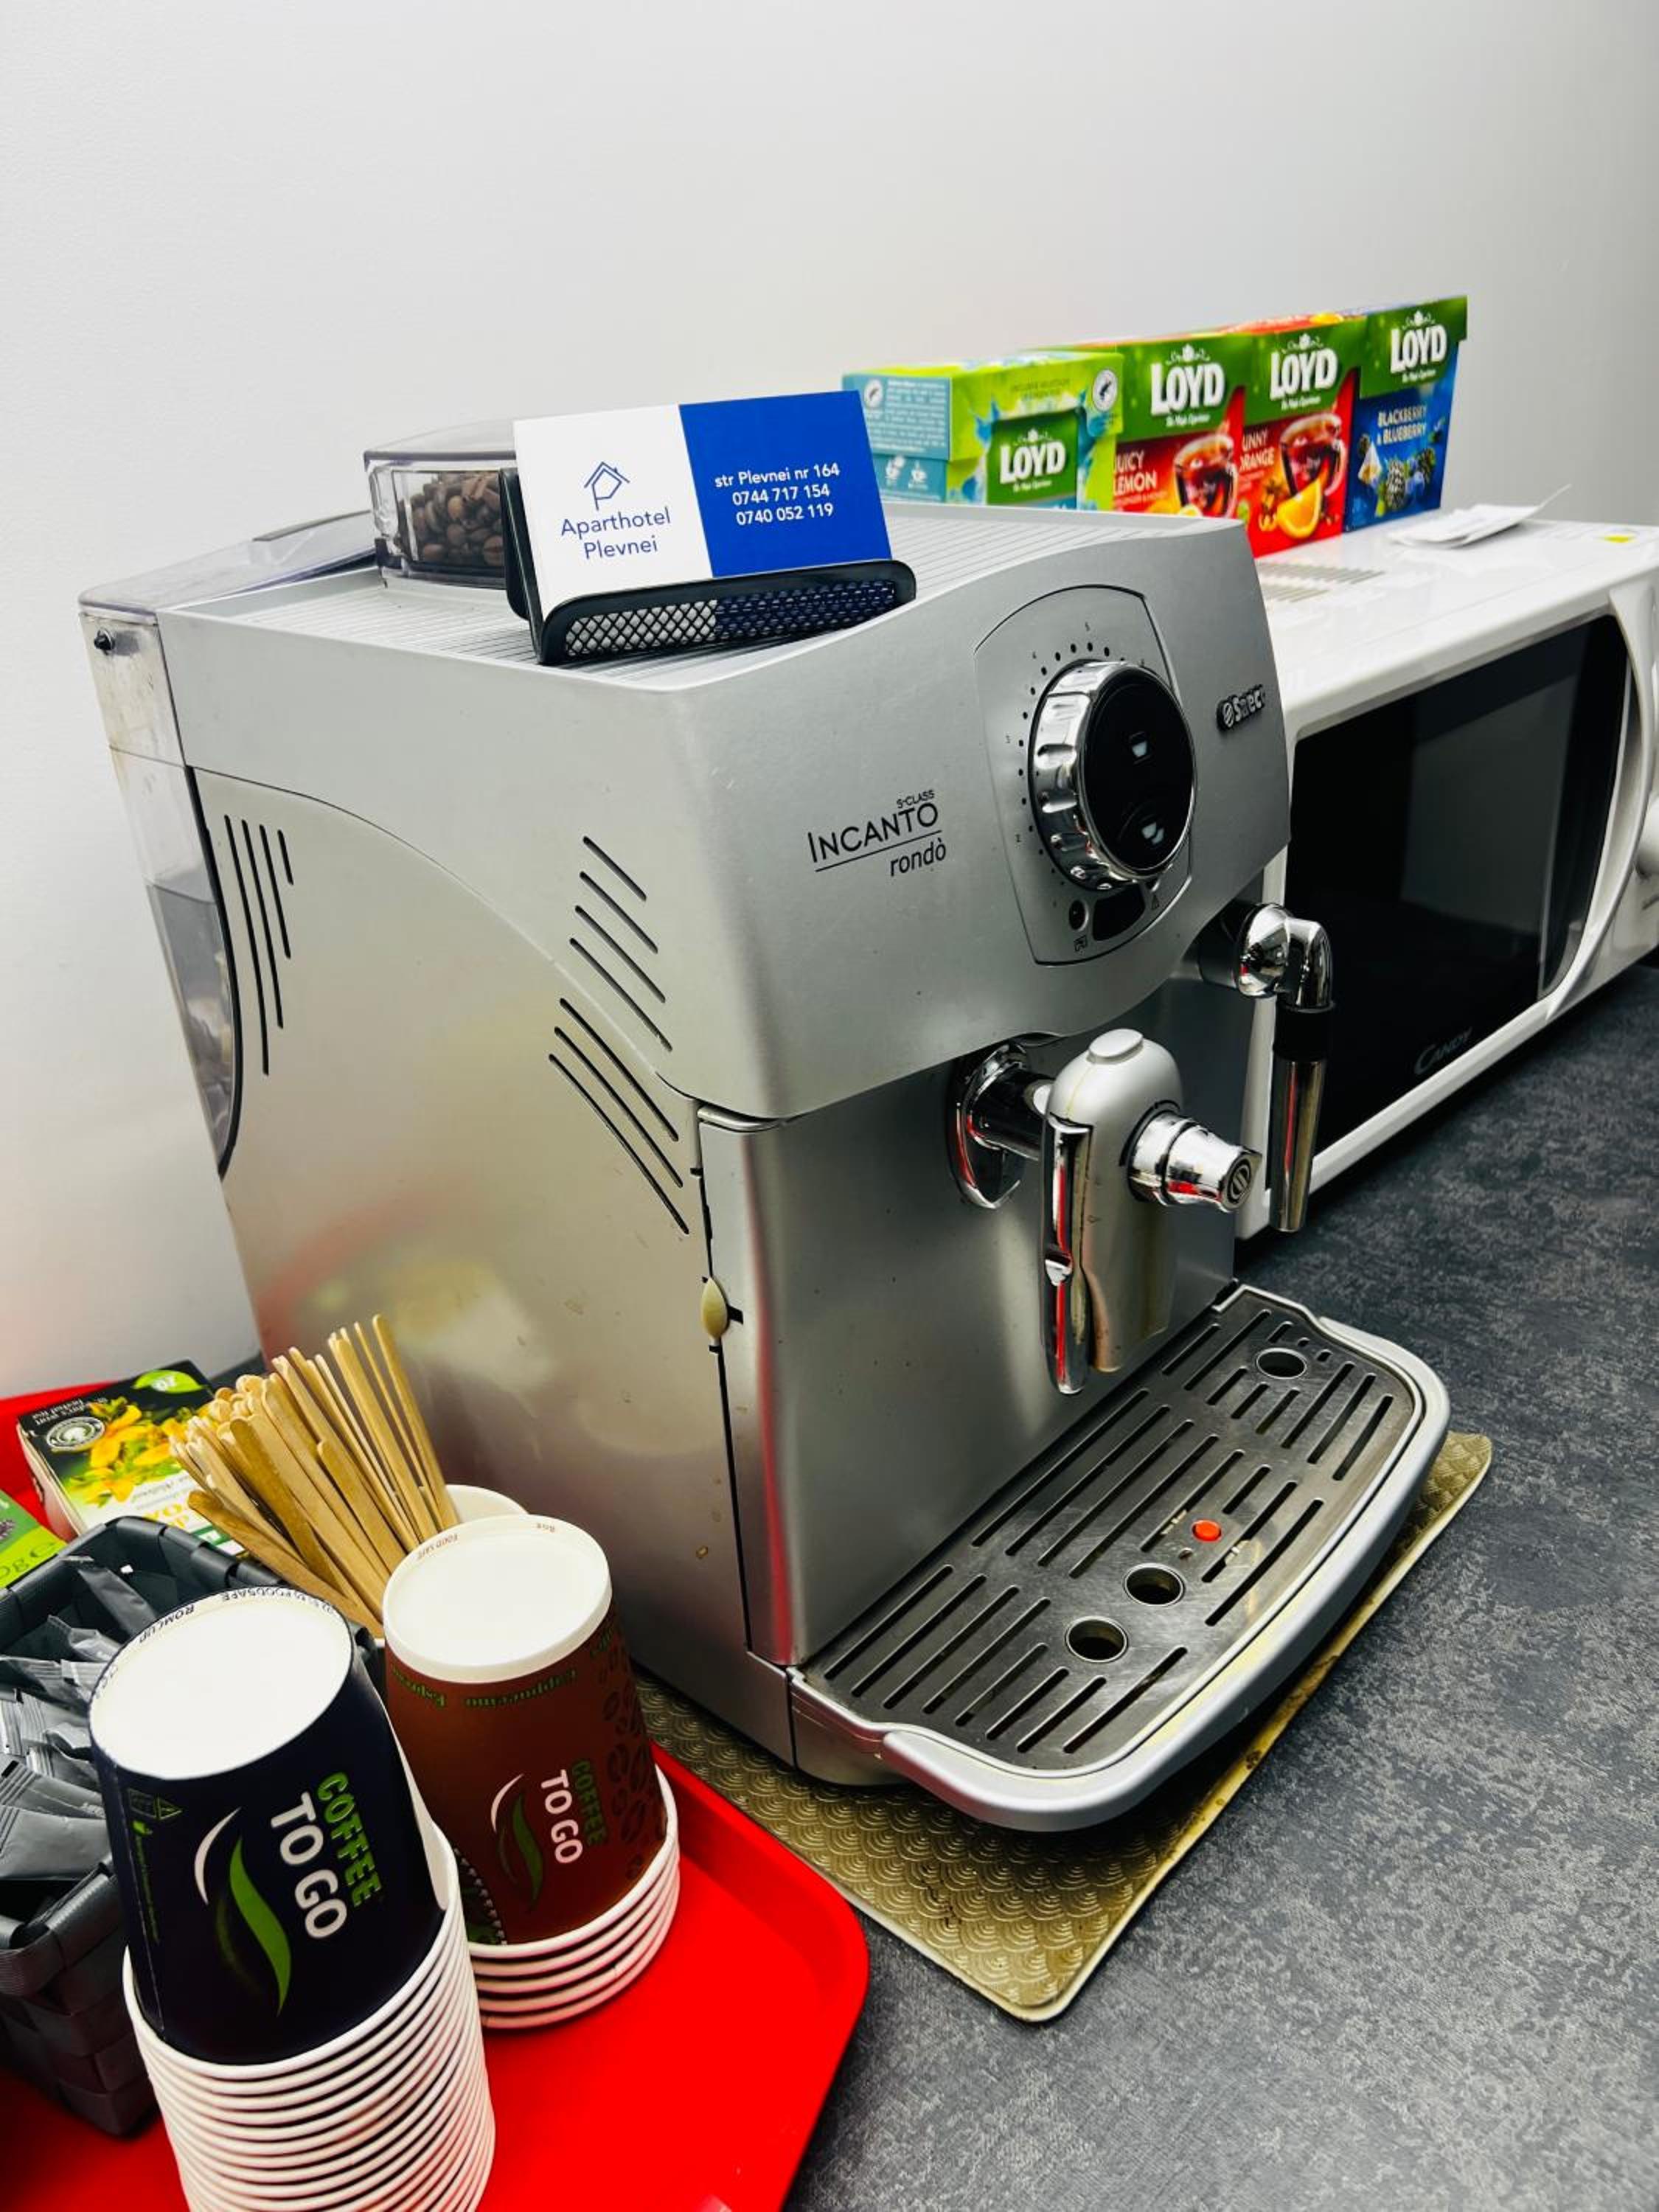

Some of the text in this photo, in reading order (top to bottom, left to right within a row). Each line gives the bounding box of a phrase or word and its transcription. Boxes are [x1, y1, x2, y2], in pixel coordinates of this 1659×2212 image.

[1390, 324, 1447, 375] LOYD
[1150, 361, 1225, 415] LOYD
[1270, 348, 1339, 401] LOYD
[1378, 406, 1427, 428] BLACKBERRY
[1383, 422, 1427, 445] BLUEBERRY
[1242, 428, 1267, 451] UNNY
[714, 462, 840, 487] str Plevnei nr 164
[999, 440, 1066, 484] LOYD
[732, 483, 830, 506] 0744 717 154
[561, 506, 671, 540] Aparthotel
[736, 503, 834, 526] 0740 052 119
[583, 535, 657, 559] Plevnei
[896, 790, 935, 809] S-CLASS
[807, 802, 939, 863] INCANTO
[889, 837, 947, 877] rondò
[540, 1769, 583, 1863] TO GO
[317, 1772, 382, 1908] COFFEE
[270, 1791, 348, 1938] TO GO
